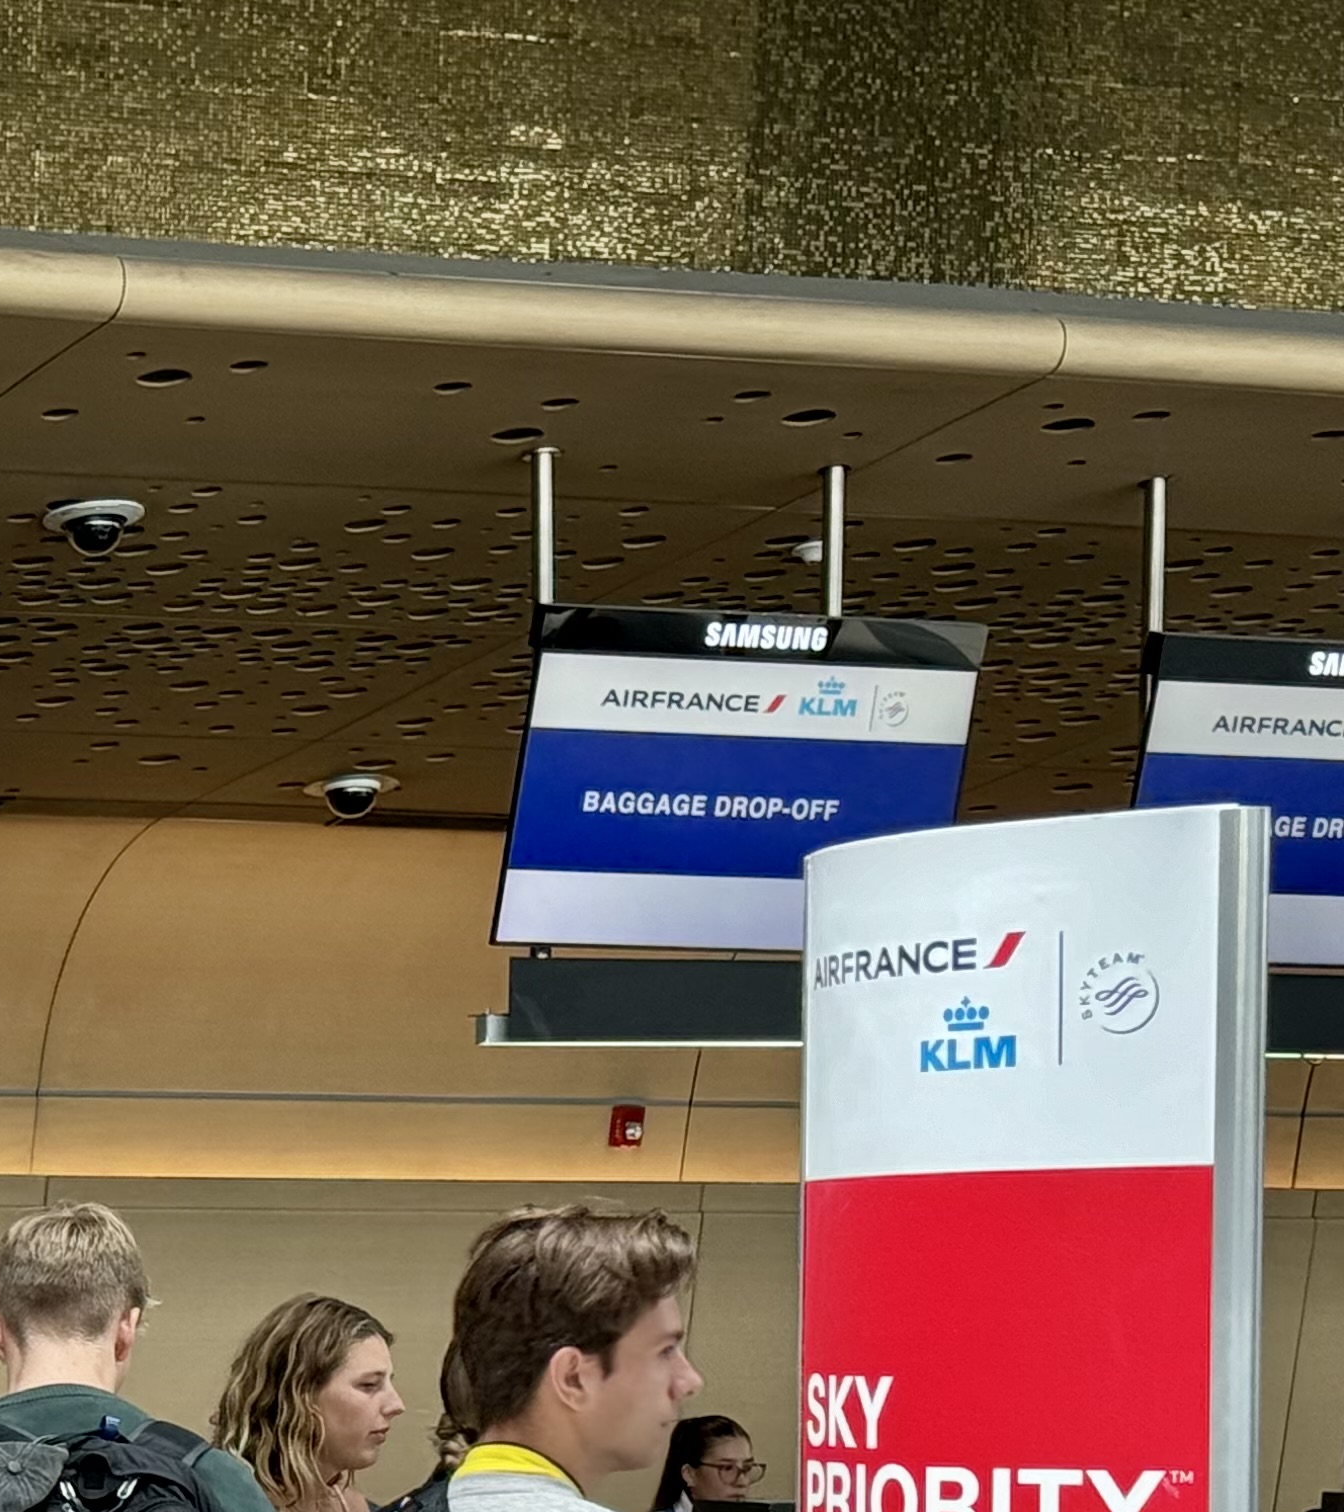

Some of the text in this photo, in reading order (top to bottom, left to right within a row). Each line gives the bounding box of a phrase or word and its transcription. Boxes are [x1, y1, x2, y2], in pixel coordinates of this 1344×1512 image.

[705, 622, 829, 652] SAMSUNG
[601, 689, 760, 714] AIRFRANCE
[798, 697, 857, 718] KLM
[1212, 715, 1344, 737] AIRFRANC
[583, 791, 840, 822] BAGGAGE DROP-OFF
[814, 938, 977, 990] AIRFRANCE
[920, 1035, 1017, 1072] KLM
[807, 1373, 894, 1449] SKY
